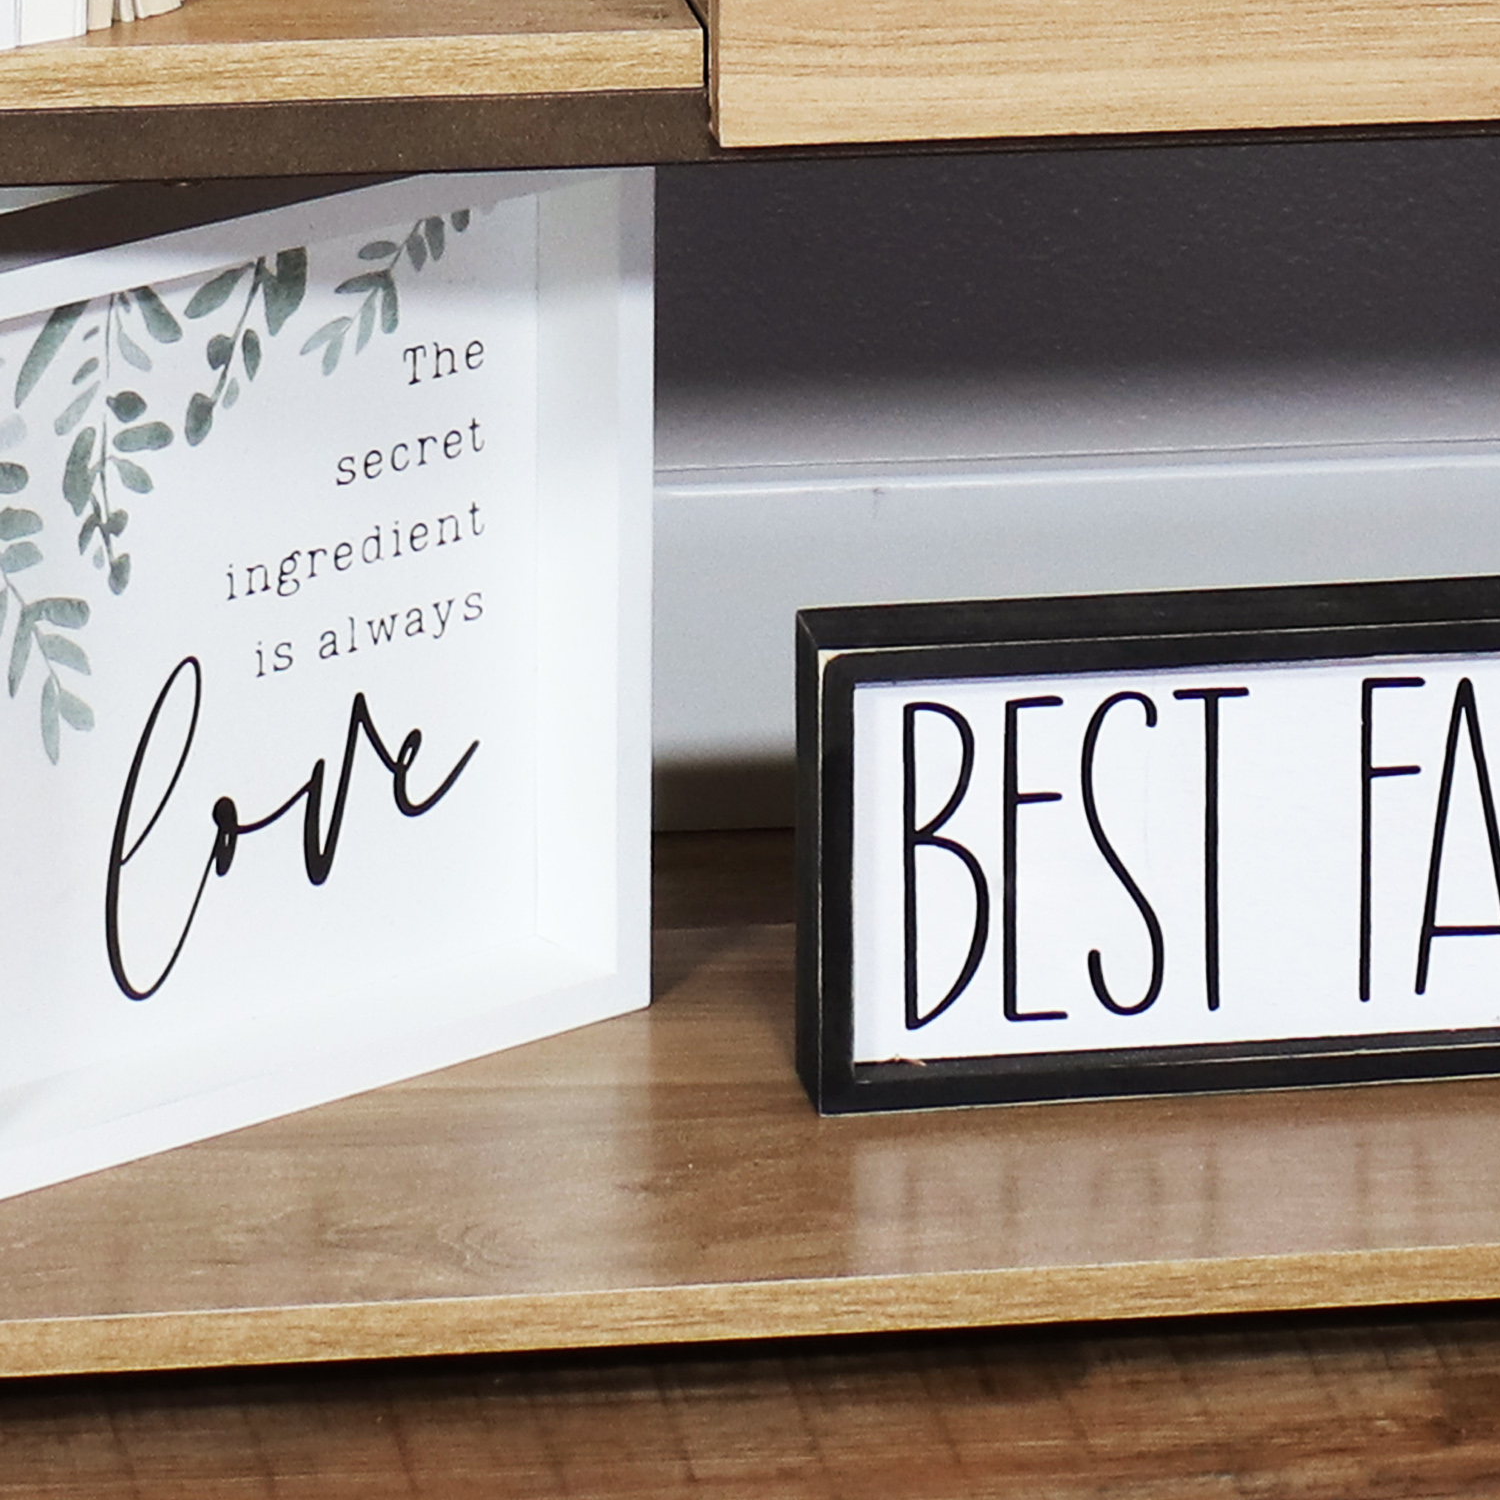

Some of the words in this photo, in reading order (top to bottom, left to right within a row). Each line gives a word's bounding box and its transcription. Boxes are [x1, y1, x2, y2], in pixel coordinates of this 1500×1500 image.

[402, 339, 486, 386] The
[335, 417, 486, 487] secret
[225, 501, 486, 600] ingredient
[255, 640, 295, 680] is
[318, 592, 485, 660] always
[104, 655, 481, 1002] love
[902, 686, 1250, 1031] BEST
